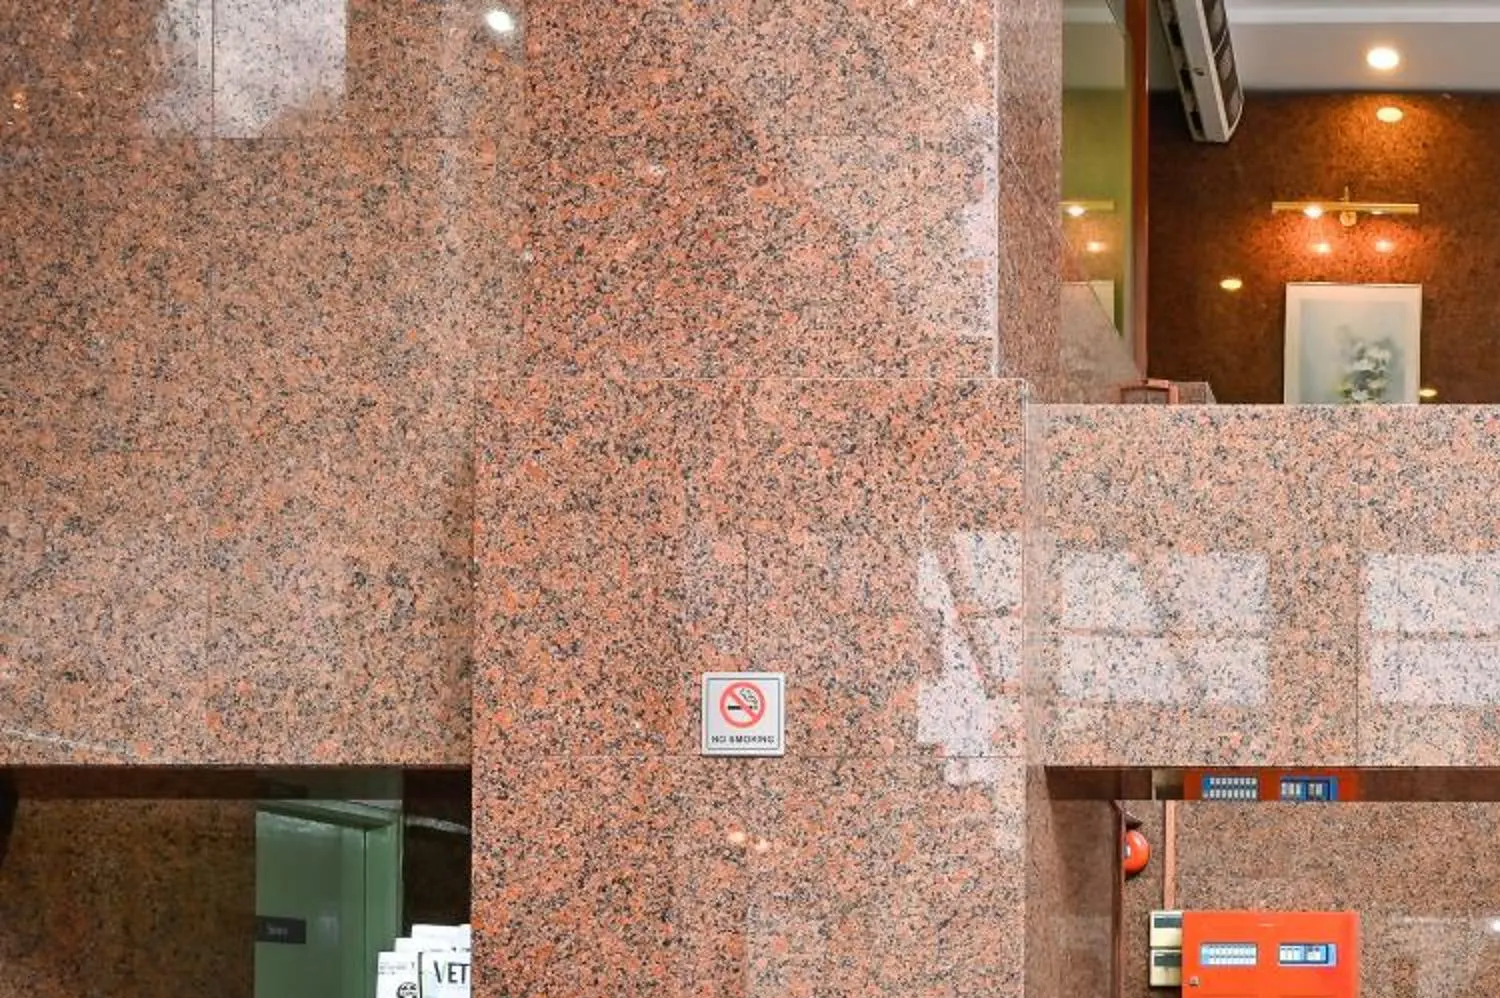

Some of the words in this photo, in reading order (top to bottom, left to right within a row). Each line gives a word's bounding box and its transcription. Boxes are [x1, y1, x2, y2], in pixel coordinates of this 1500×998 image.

[711, 735, 727, 743] NO
[730, 735, 776, 744] SMOKING
[433, 960, 471, 985] VET
